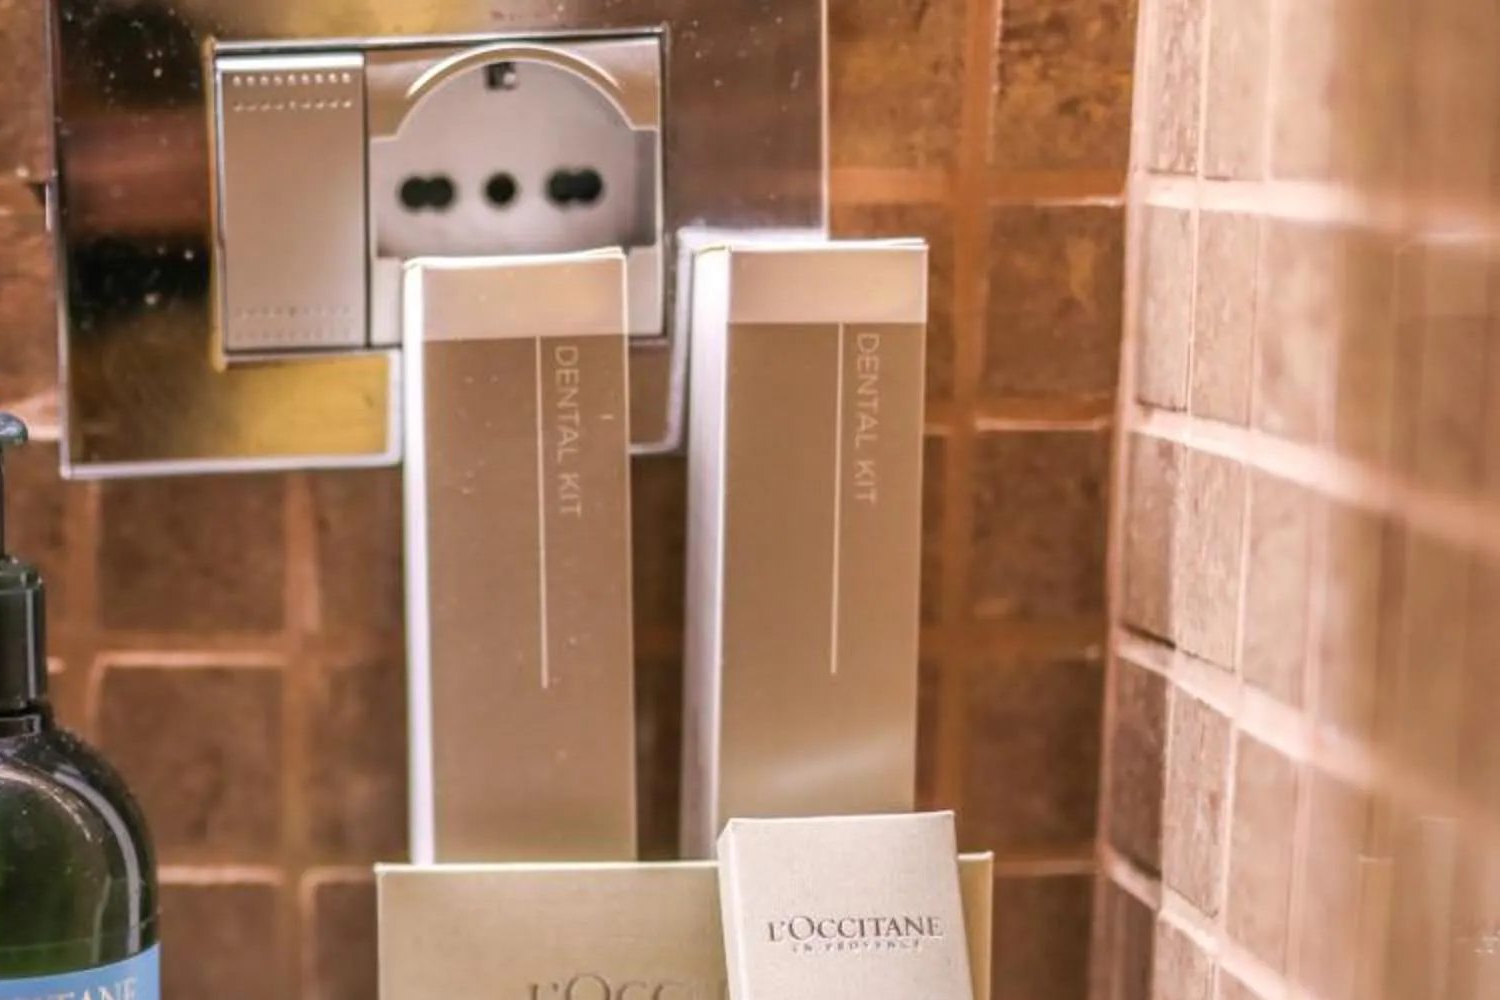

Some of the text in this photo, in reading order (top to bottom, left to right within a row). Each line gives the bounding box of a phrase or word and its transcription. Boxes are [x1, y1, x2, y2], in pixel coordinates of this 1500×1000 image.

[553, 344, 582, 518] DENTAL KIT
[854, 332, 880, 503] DENTAL KIT
[767, 915, 944, 942] L'OCCITANE
